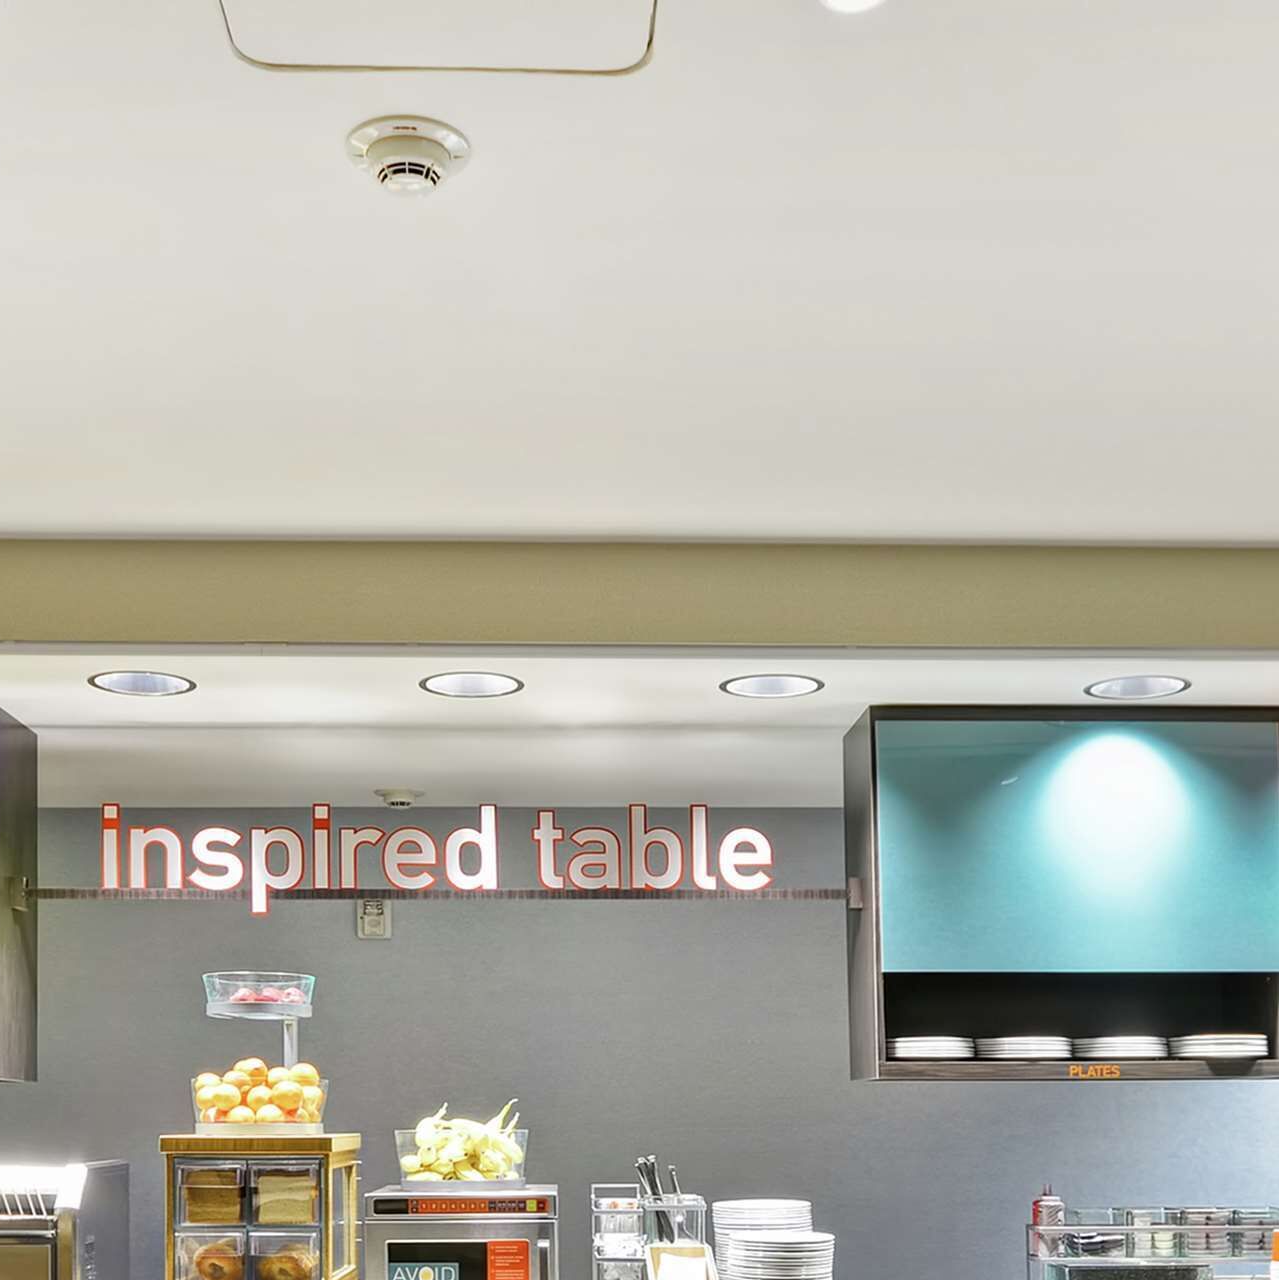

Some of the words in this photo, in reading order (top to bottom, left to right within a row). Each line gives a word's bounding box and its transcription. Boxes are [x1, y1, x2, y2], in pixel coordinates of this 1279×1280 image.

[101, 804, 498, 915] inspired
[532, 804, 774, 890] table
[1069, 1064, 1121, 1078] PLATES
